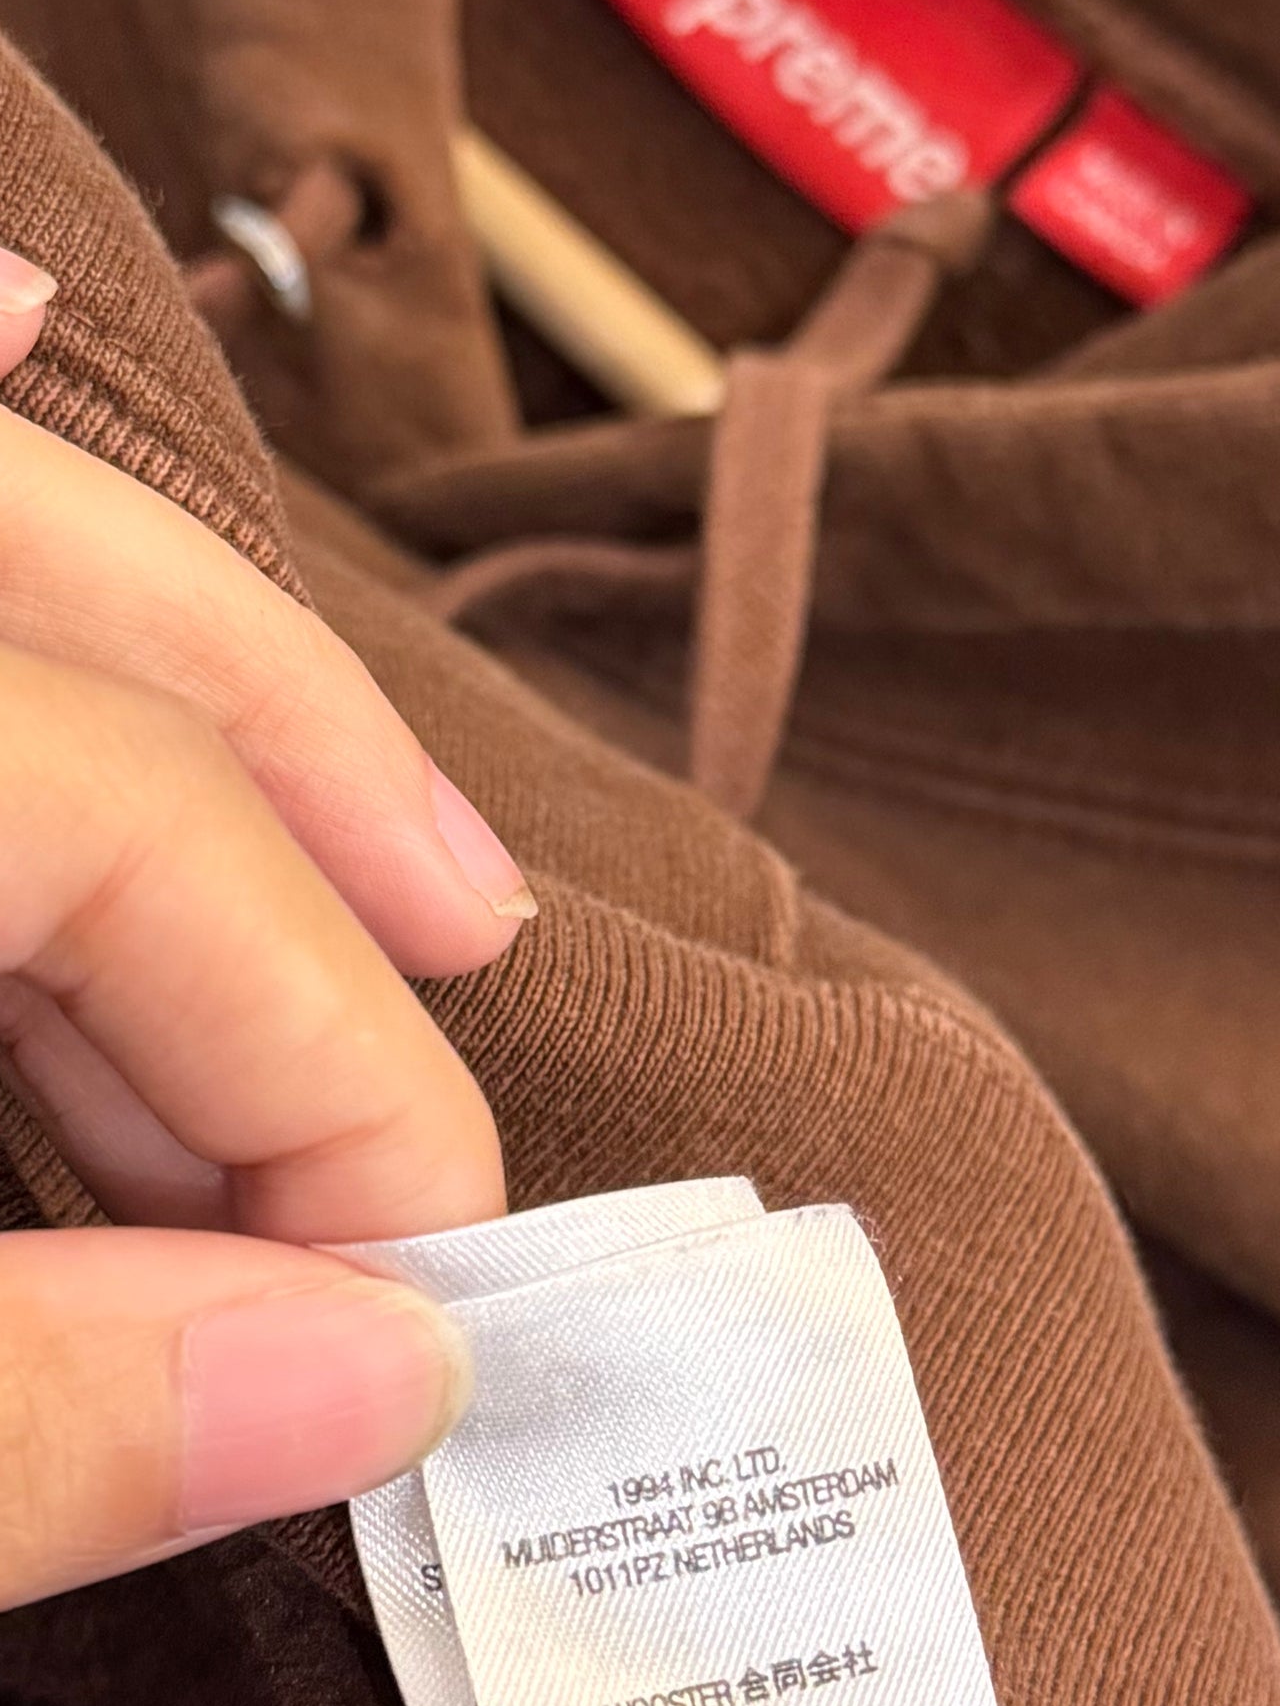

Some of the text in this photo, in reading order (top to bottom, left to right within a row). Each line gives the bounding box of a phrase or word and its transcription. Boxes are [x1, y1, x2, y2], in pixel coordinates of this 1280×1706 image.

[501, 1503, 694, 1570] MUIDERSTRAAT
[743, 1457, 900, 1522] AMSTERDAM
[606, 1445, 787, 1509] 1994 INC. LTD.
[570, 1509, 856, 1598] 1011PZ NETHERLANDS
[737, 1639, 880, 1705] 合同会社
